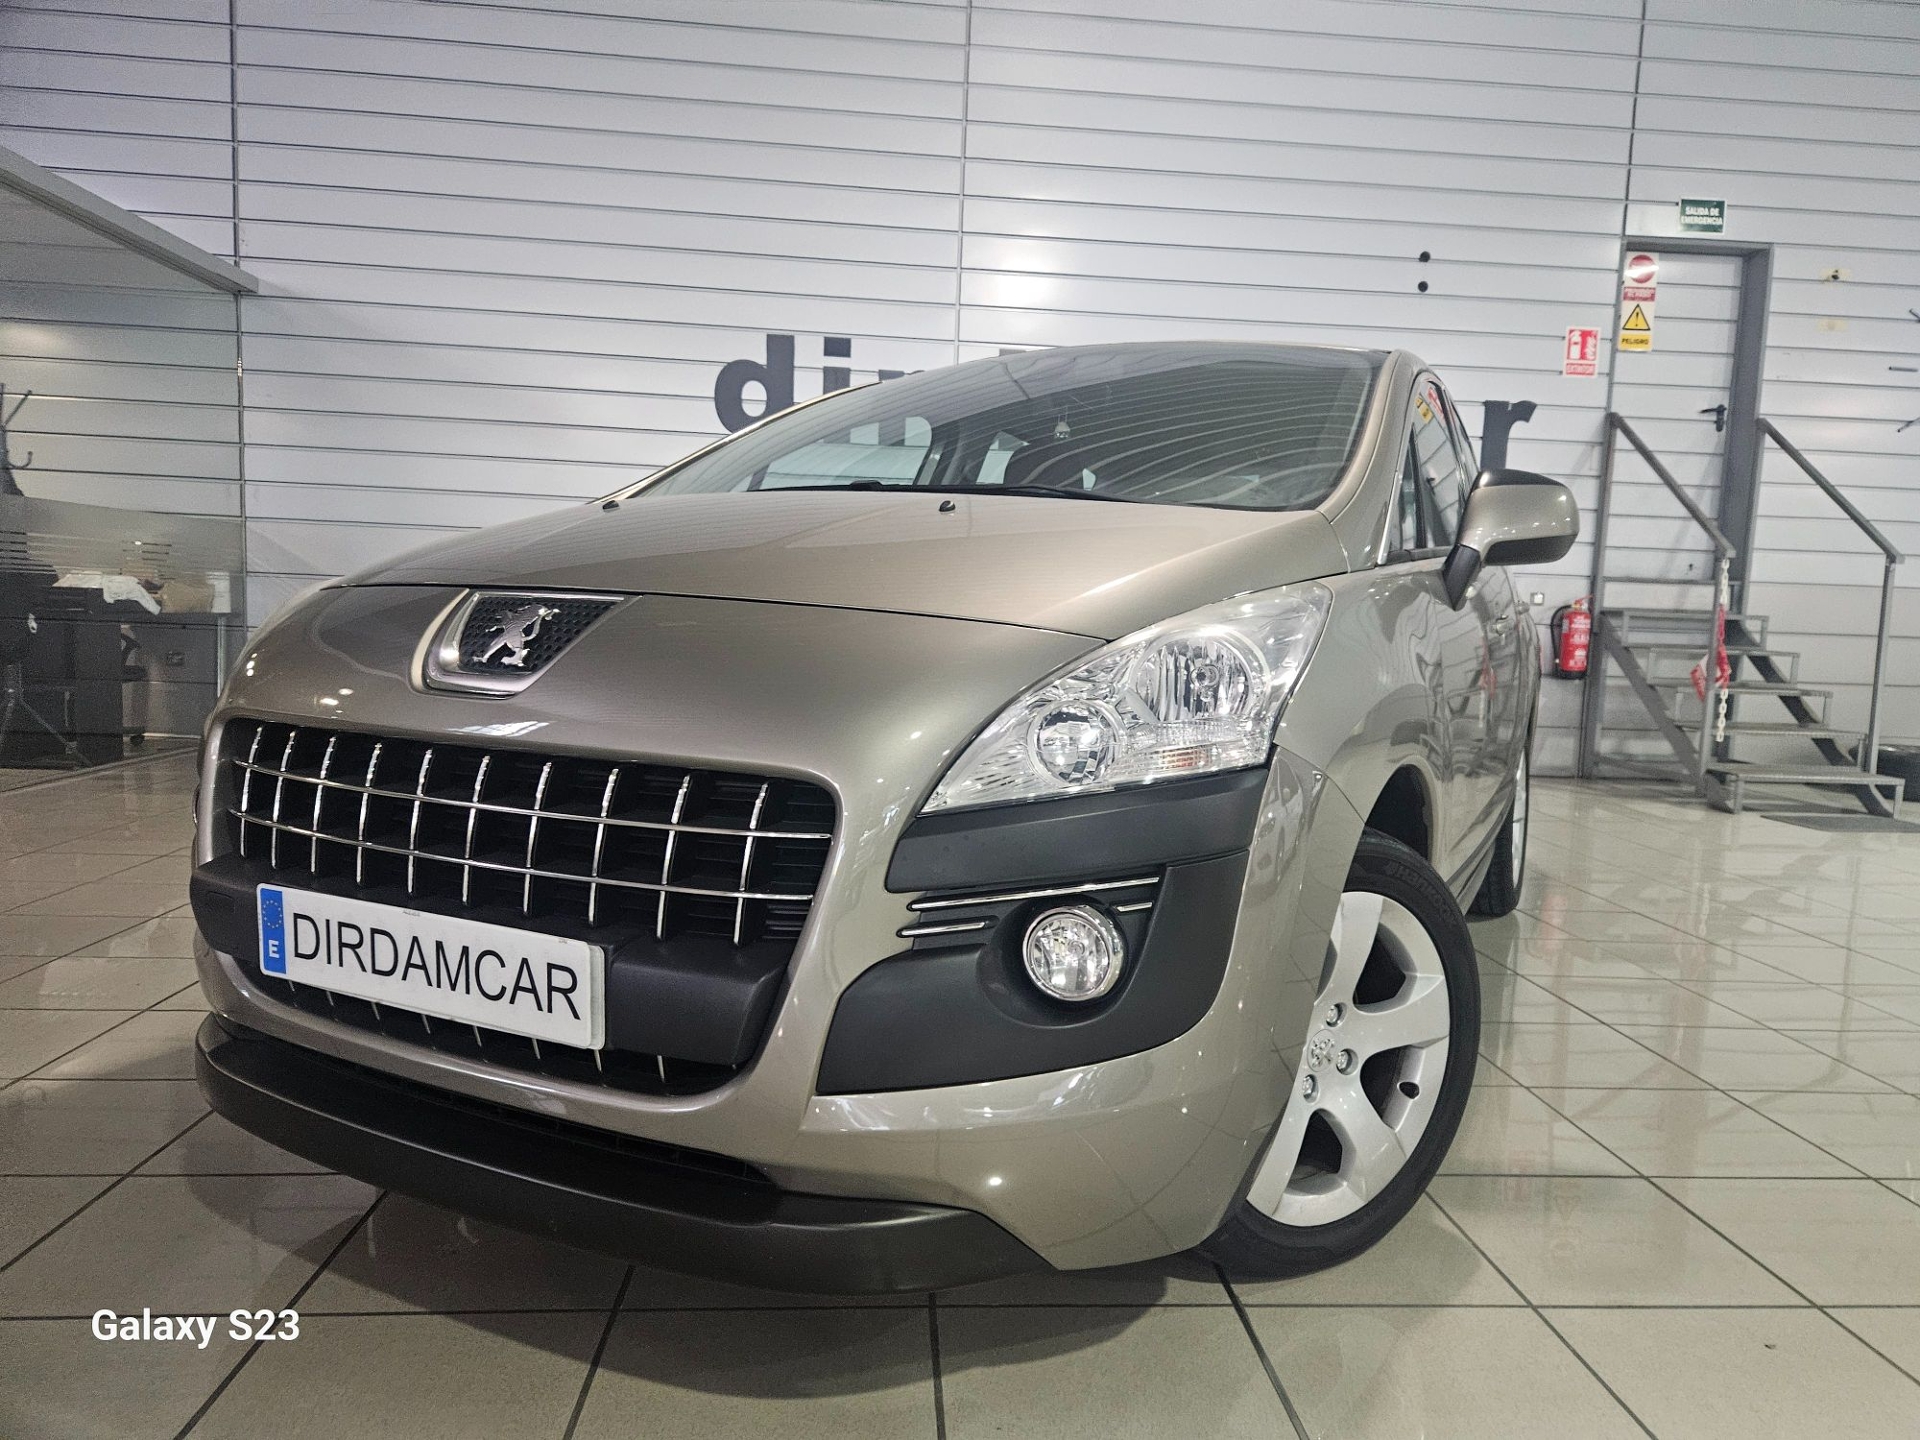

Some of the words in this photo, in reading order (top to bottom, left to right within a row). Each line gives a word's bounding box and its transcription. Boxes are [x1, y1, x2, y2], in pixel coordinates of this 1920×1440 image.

[1710, 207, 1720, 216] DE
[268, 940, 280, 959] E
[293, 912, 581, 1020] DIRDAMCAR
